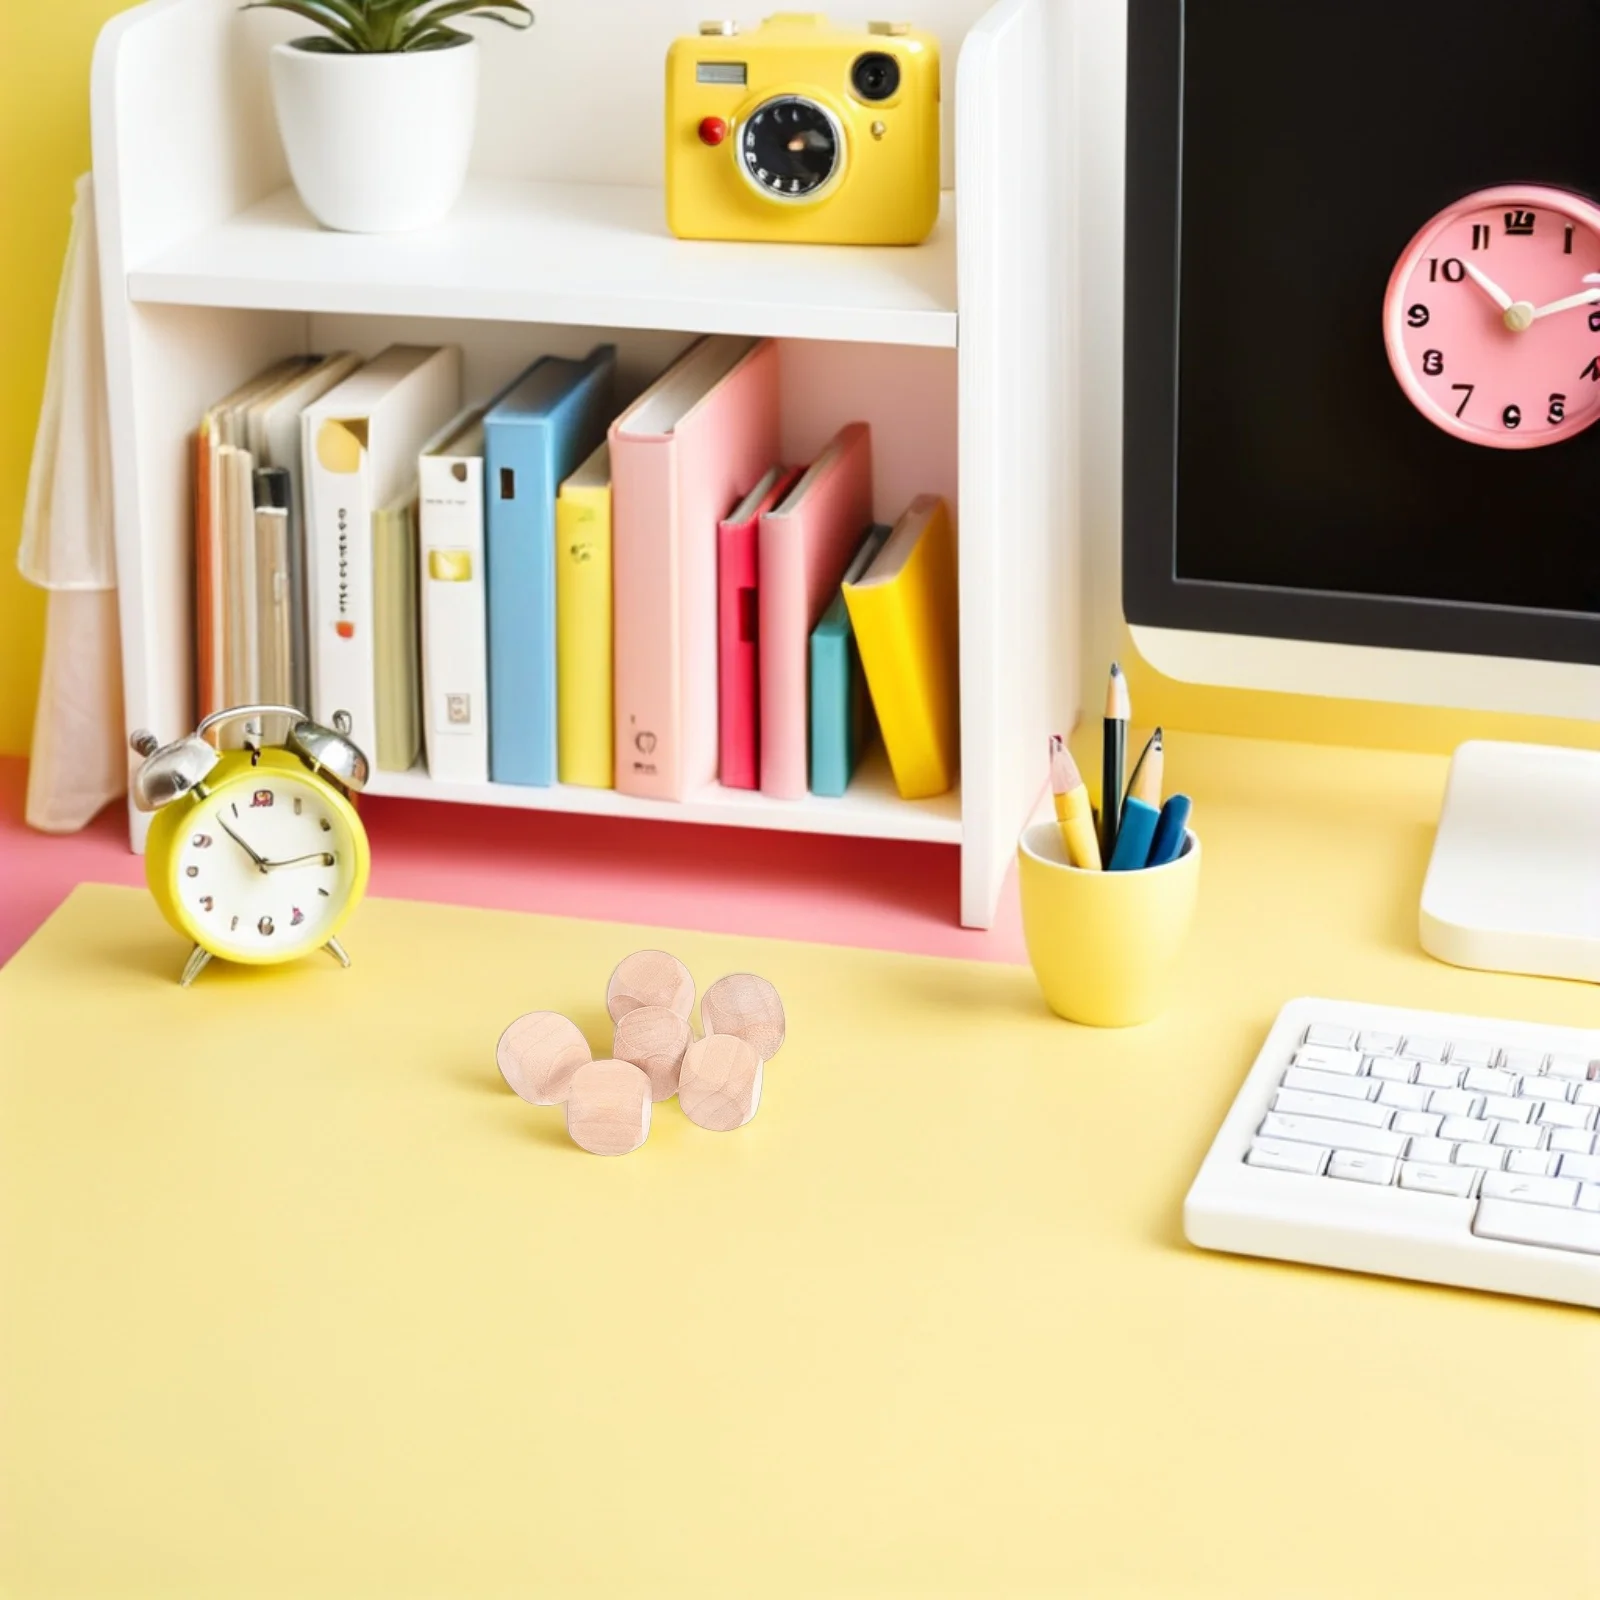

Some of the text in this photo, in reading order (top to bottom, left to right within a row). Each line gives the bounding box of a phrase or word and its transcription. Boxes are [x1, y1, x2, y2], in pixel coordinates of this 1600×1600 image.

[1429, 258, 1465, 283] 10
[1407, 304, 1430, 328] 9
[1451, 383, 1474, 418] 7
